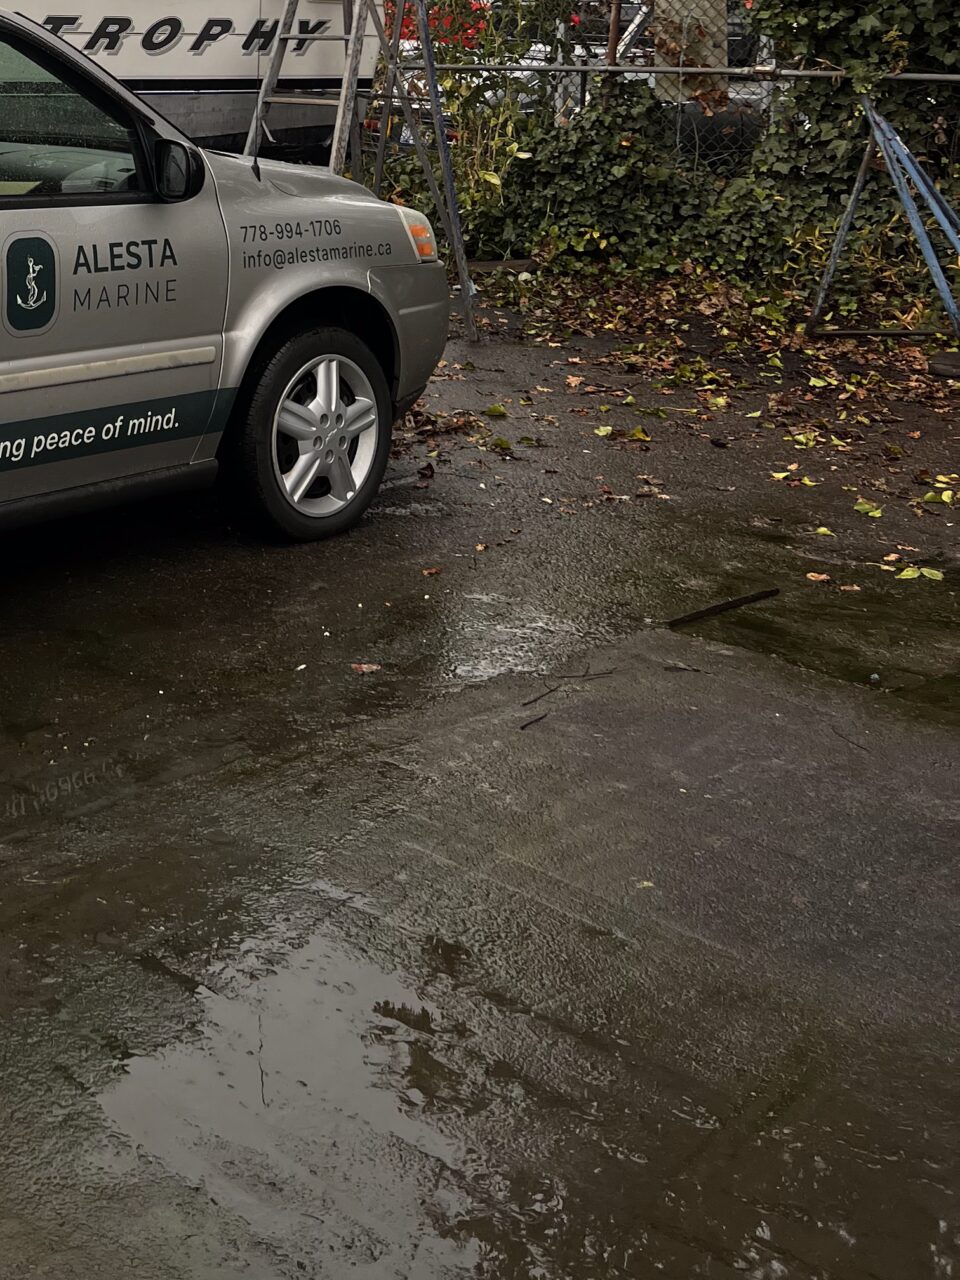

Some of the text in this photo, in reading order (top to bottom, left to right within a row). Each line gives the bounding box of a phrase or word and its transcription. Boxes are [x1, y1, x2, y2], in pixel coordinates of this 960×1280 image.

[40, 15, 332, 56] TROPHY
[240, 219, 342, 244] 778-994-1706
[73, 238, 178, 275] ALESTA
[243, 240, 392, 269] info@alestamarine.ca
[73, 279, 177, 312] MARINE
[30, 428, 96, 454] peace
[101, 419, 124, 439] of
[127, 407, 181, 438] mind.
